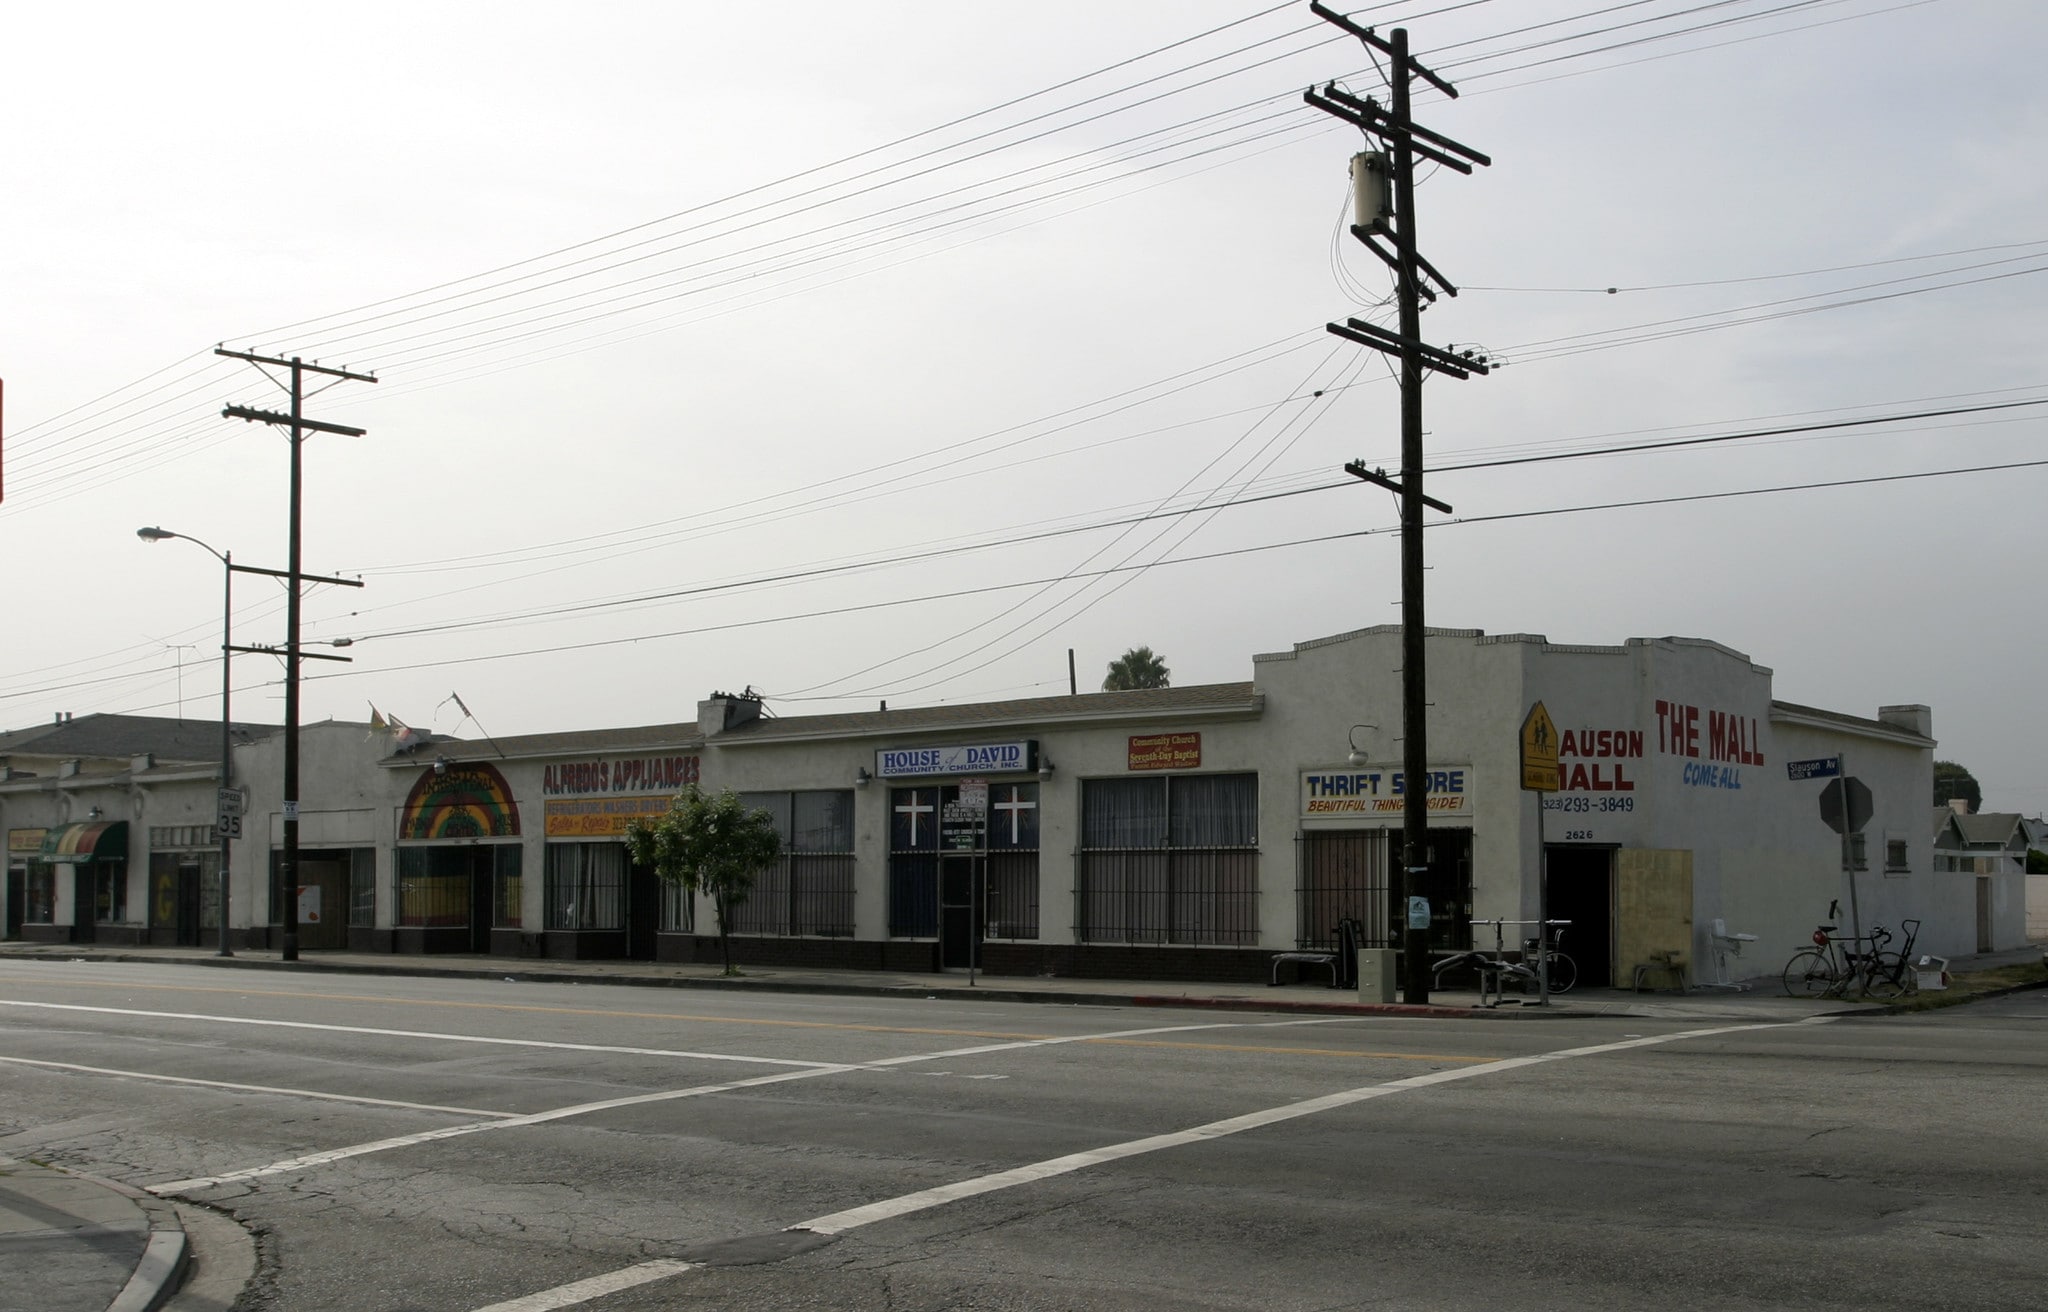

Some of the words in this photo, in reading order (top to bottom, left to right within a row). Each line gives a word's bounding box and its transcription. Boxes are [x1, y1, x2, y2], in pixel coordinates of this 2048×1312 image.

[1132, 736, 1170, 747] Community
[1171, 734, 1197, 745] Church
[1656, 700, 1699, 758] THE
[1709, 711, 1764, 767] MALL
[1560, 730, 1644, 758] AUSON
[884, 750, 941, 768] HOUSE
[945, 748, 964, 770] of
[967, 745, 1021, 764] DAVID
[1174, 749, 1199, 761] Baptist
[883, 765, 945, 775] COMMUNITY
[949, 761, 997, 772] CHURCH,
[1001, 760, 1024, 769] INC.
[1790, 762, 1821, 773] Slauson
[1826, 759, 1836, 769] Av
[543, 757, 609, 795] ALFREDO'S
[612, 756, 700, 792] APPLIANCES
[1307, 774, 1382, 797] THRIFT
[1391, 770, 1464, 795] SORE
[1683, 761, 1717, 786] COME
[1718, 766, 1742, 790] ALL
[221, 791, 242, 802] SPEED
[1308, 799, 1366, 812] BEAUTIFUL
[1371, 799, 1406, 811] THING
[1425, 797, 1465, 810] SIDE!
[219, 815, 240, 834] 35
[1566, 830, 1594, 840] 2626
